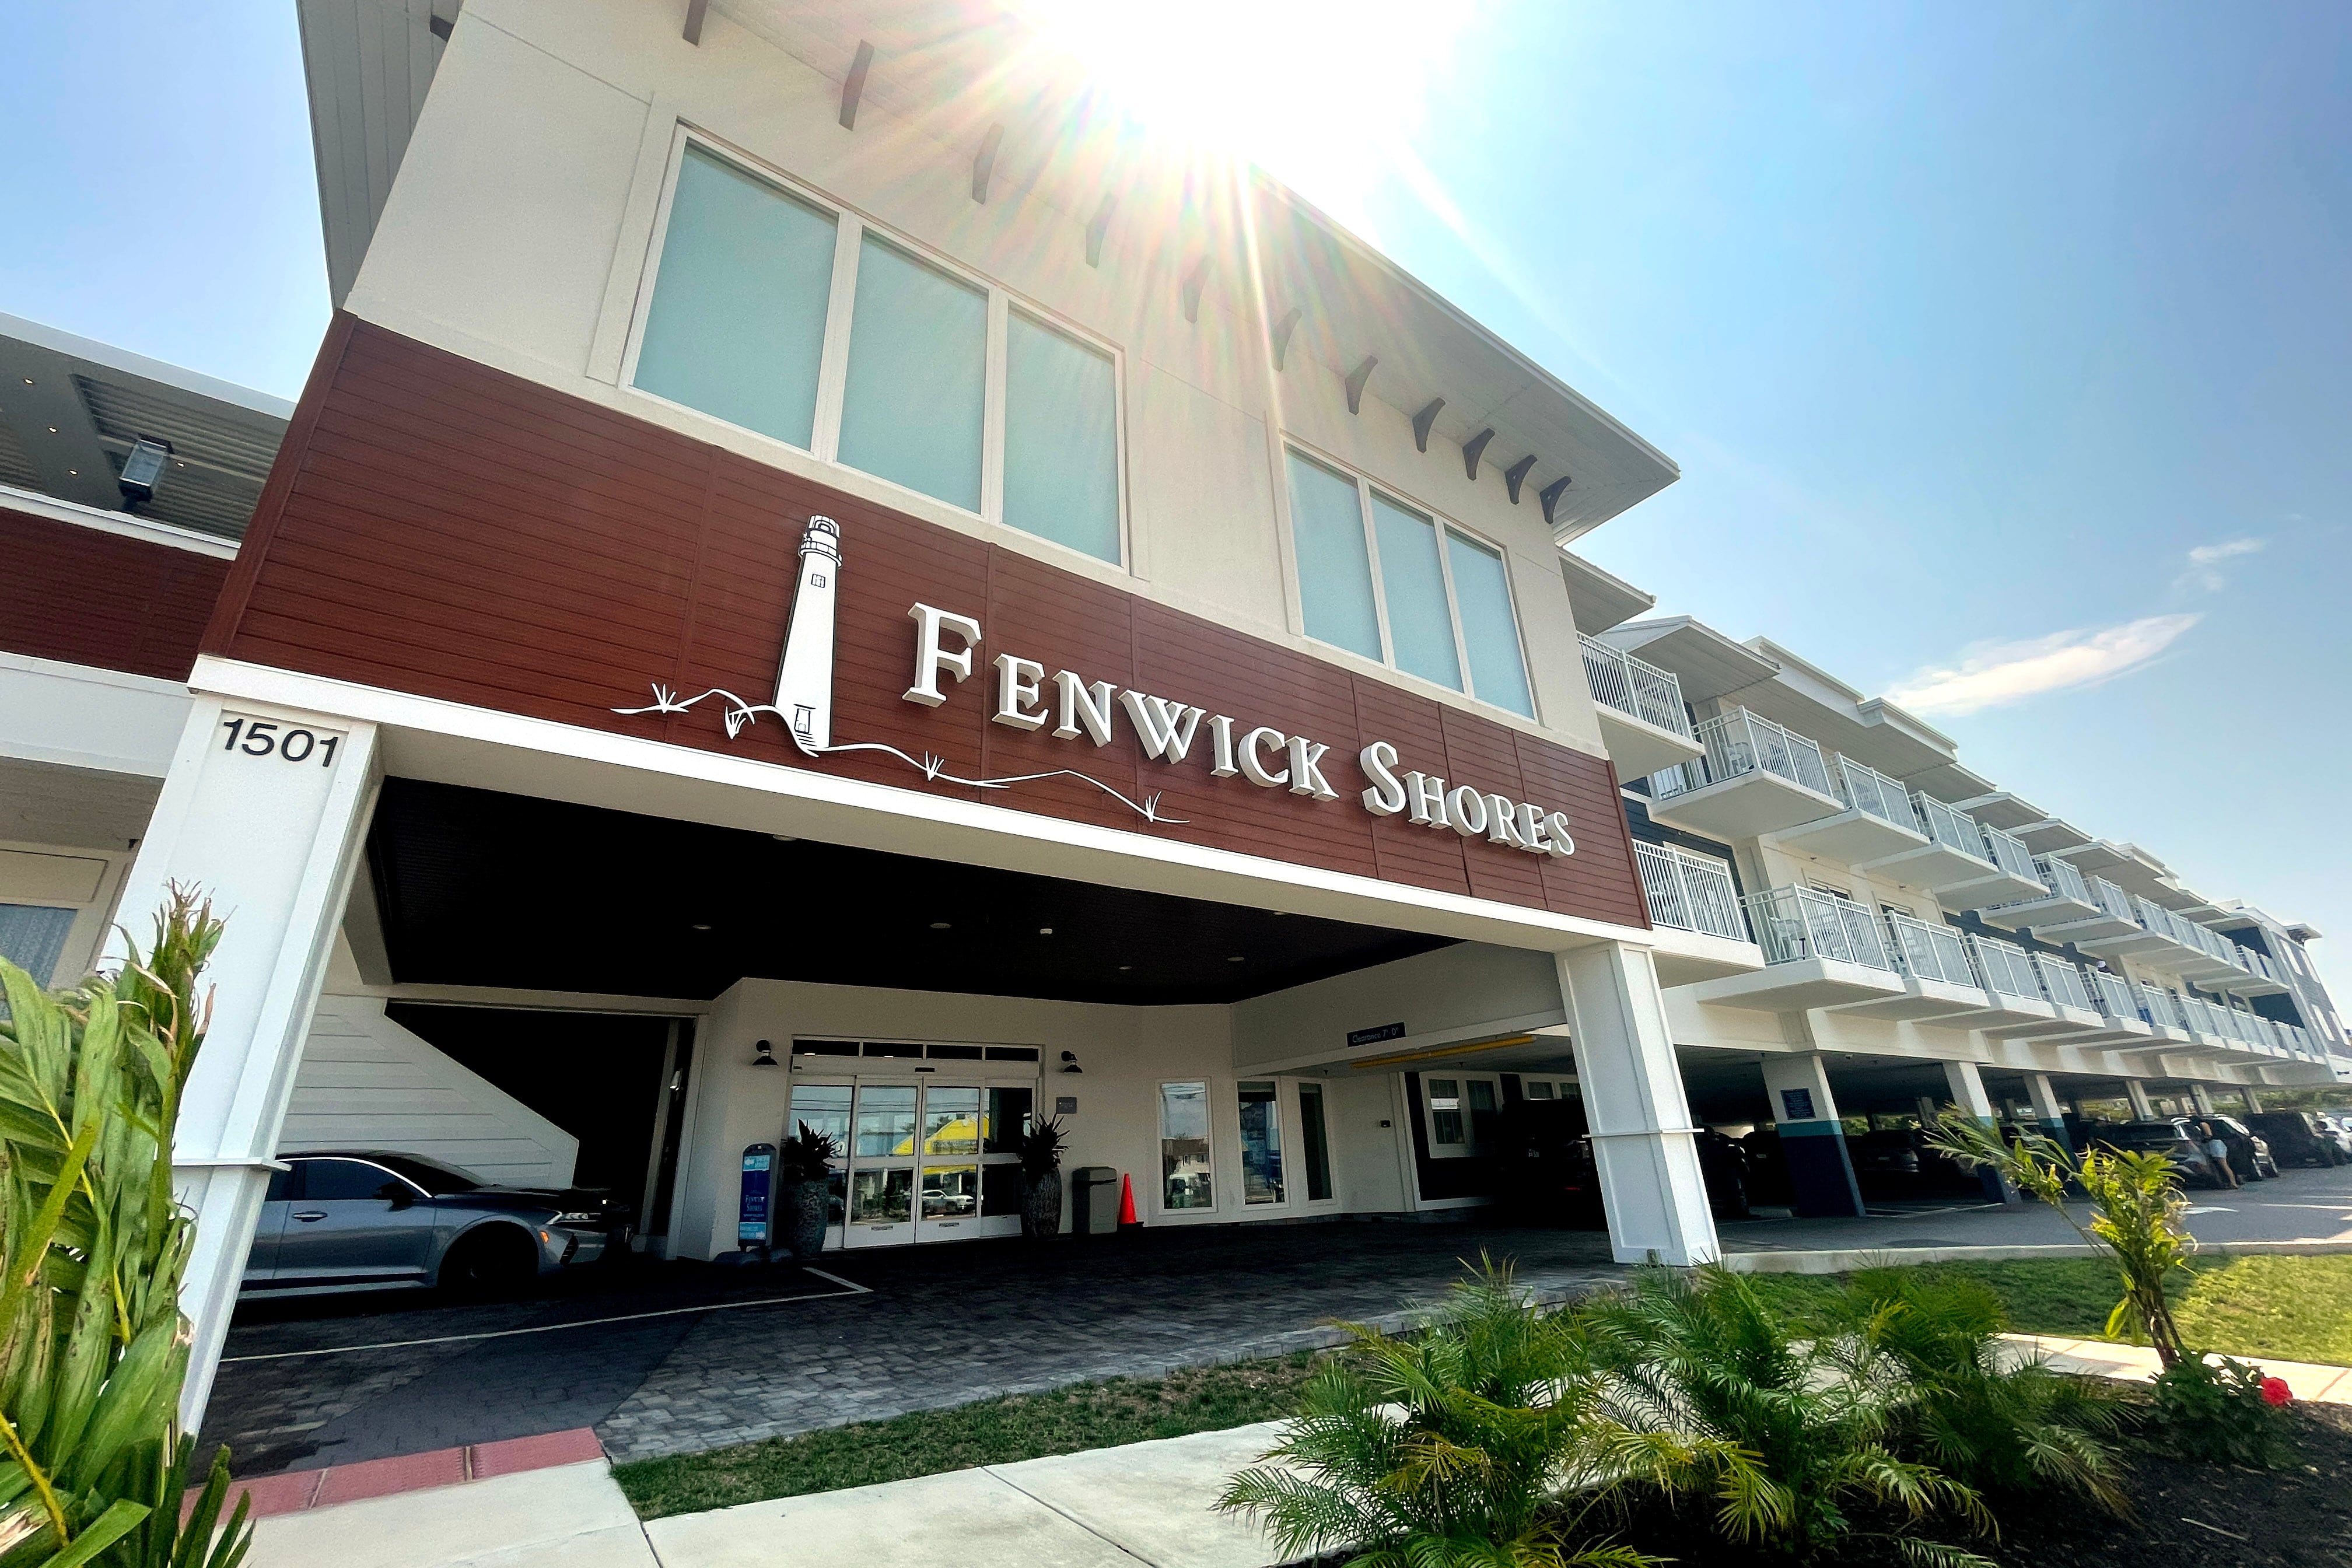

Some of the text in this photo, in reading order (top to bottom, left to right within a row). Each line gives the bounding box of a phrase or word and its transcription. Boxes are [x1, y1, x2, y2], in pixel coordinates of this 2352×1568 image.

[223, 718, 339, 768] 1501
[902, 601, 1575, 859] FENWICK SHORES
